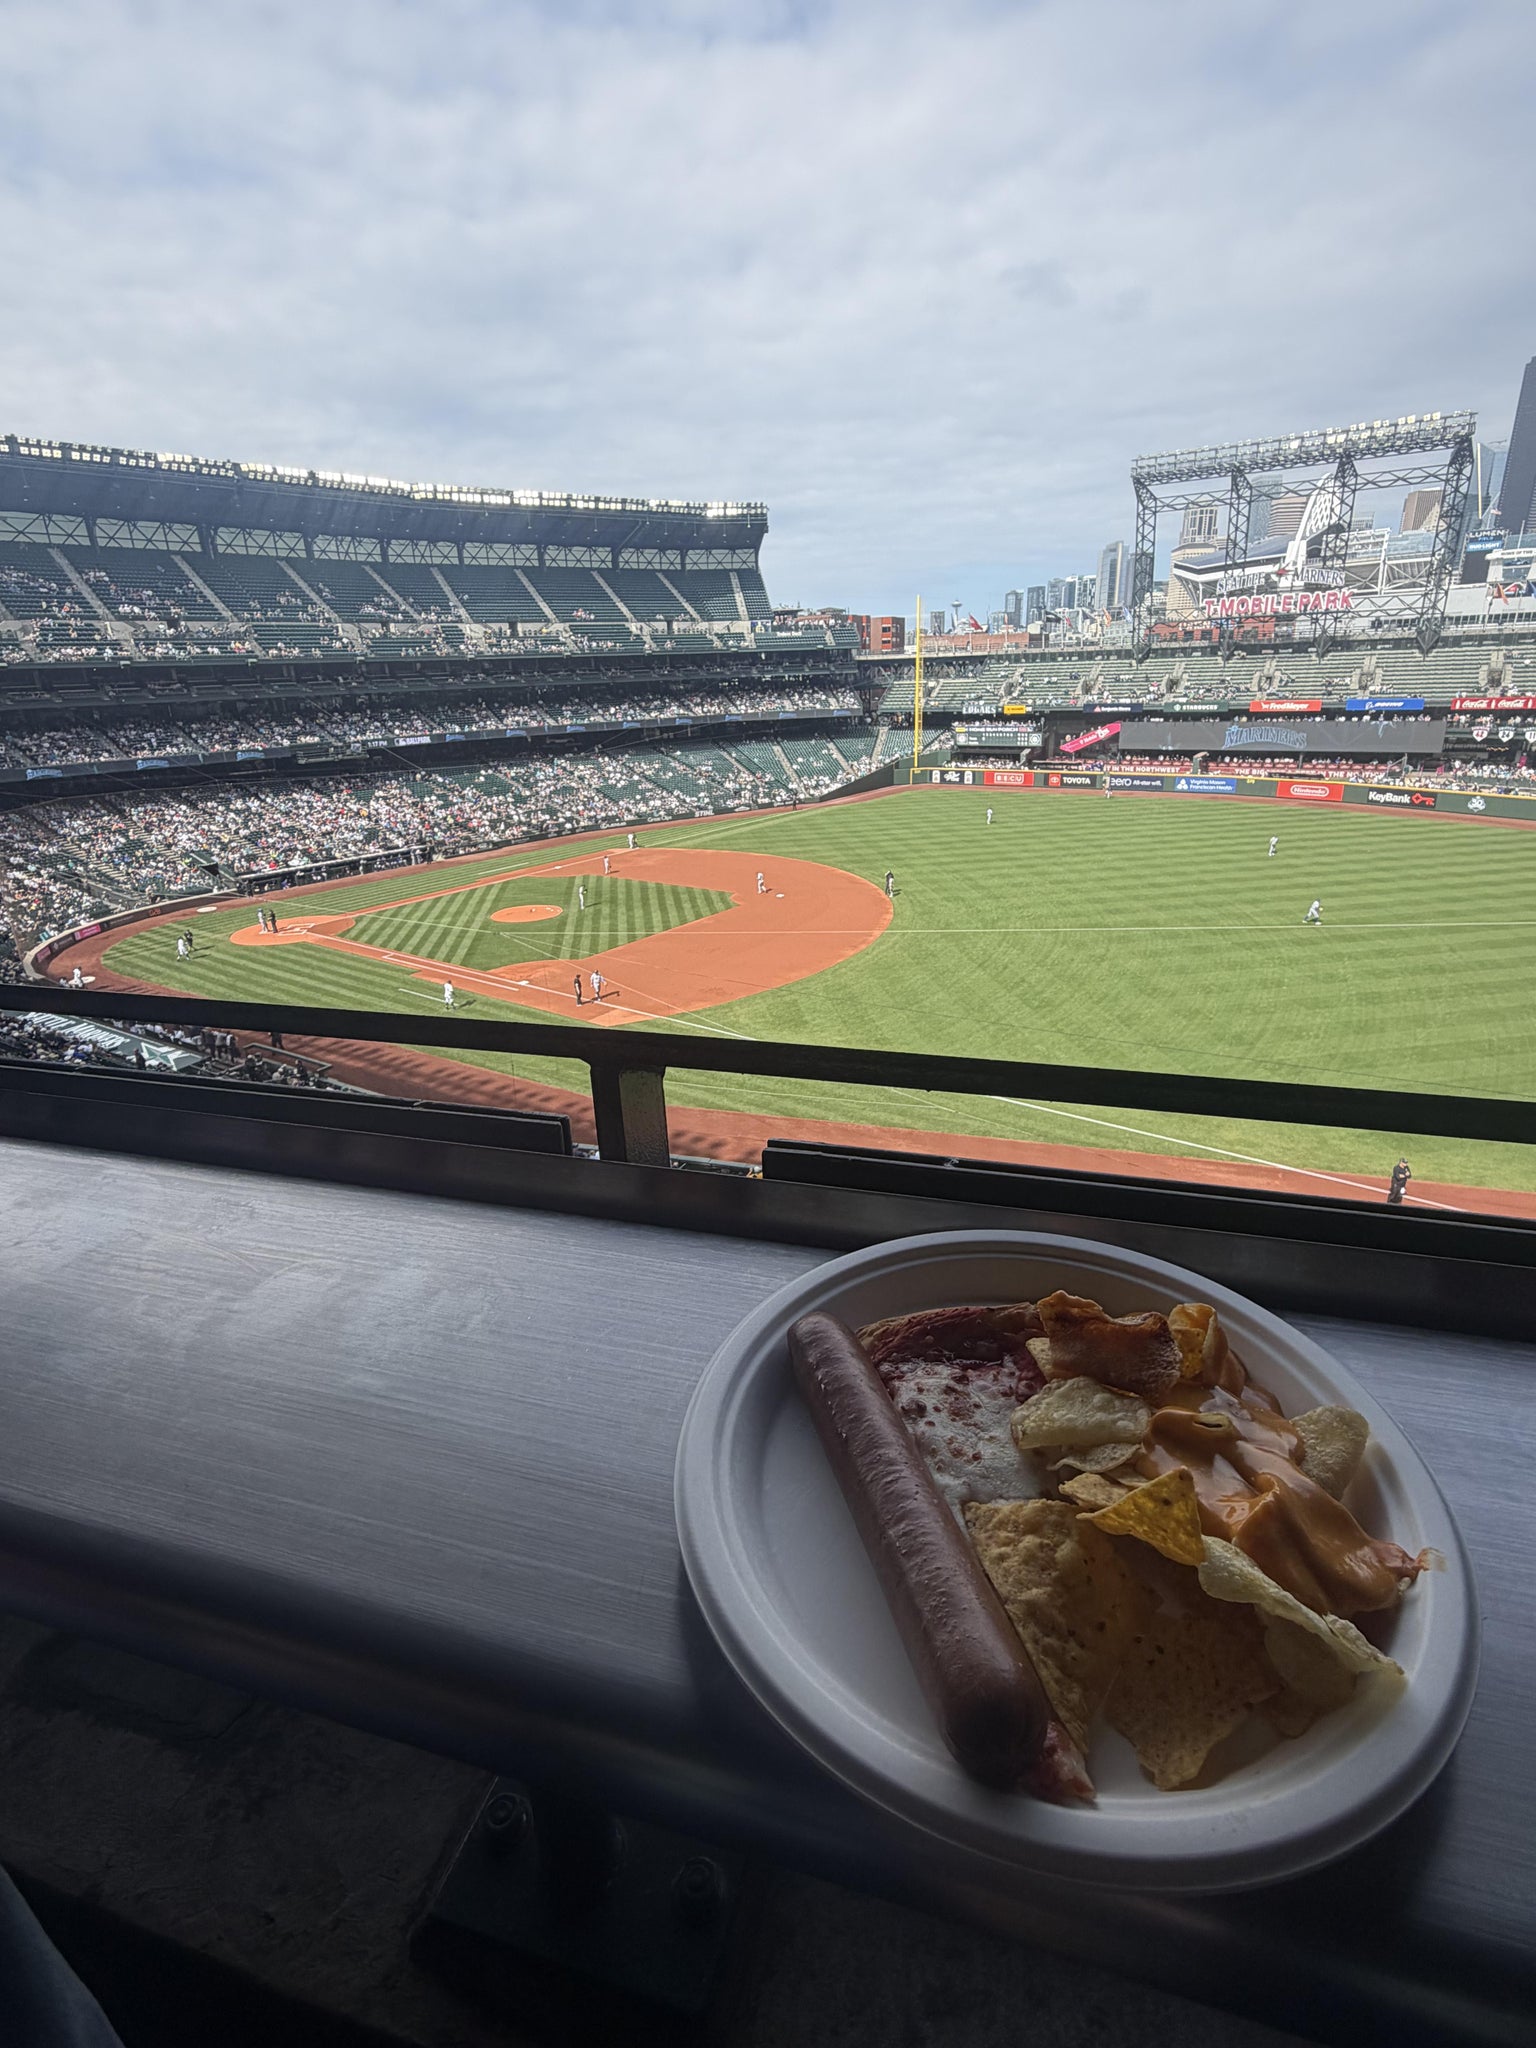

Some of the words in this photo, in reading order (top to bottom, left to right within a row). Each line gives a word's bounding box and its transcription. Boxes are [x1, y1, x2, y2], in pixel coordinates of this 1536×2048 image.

[1469, 530, 1504, 538] LUMEN
[1294, 566, 1346, 586] MARINERS
[1204, 593, 1294, 617] T-MOBILE
[1297, 590, 1355, 612] PARK
[1222, 725, 1307, 750] MARINERS
[1135, 765, 1180, 773] NORTHWEST
[1062, 776, 1091, 785] TOYOTA
[1294, 787, 1326, 795] Nintendo
[1368, 791, 1410, 804] KeyBank
[694, 809, 715, 818] STIHL
